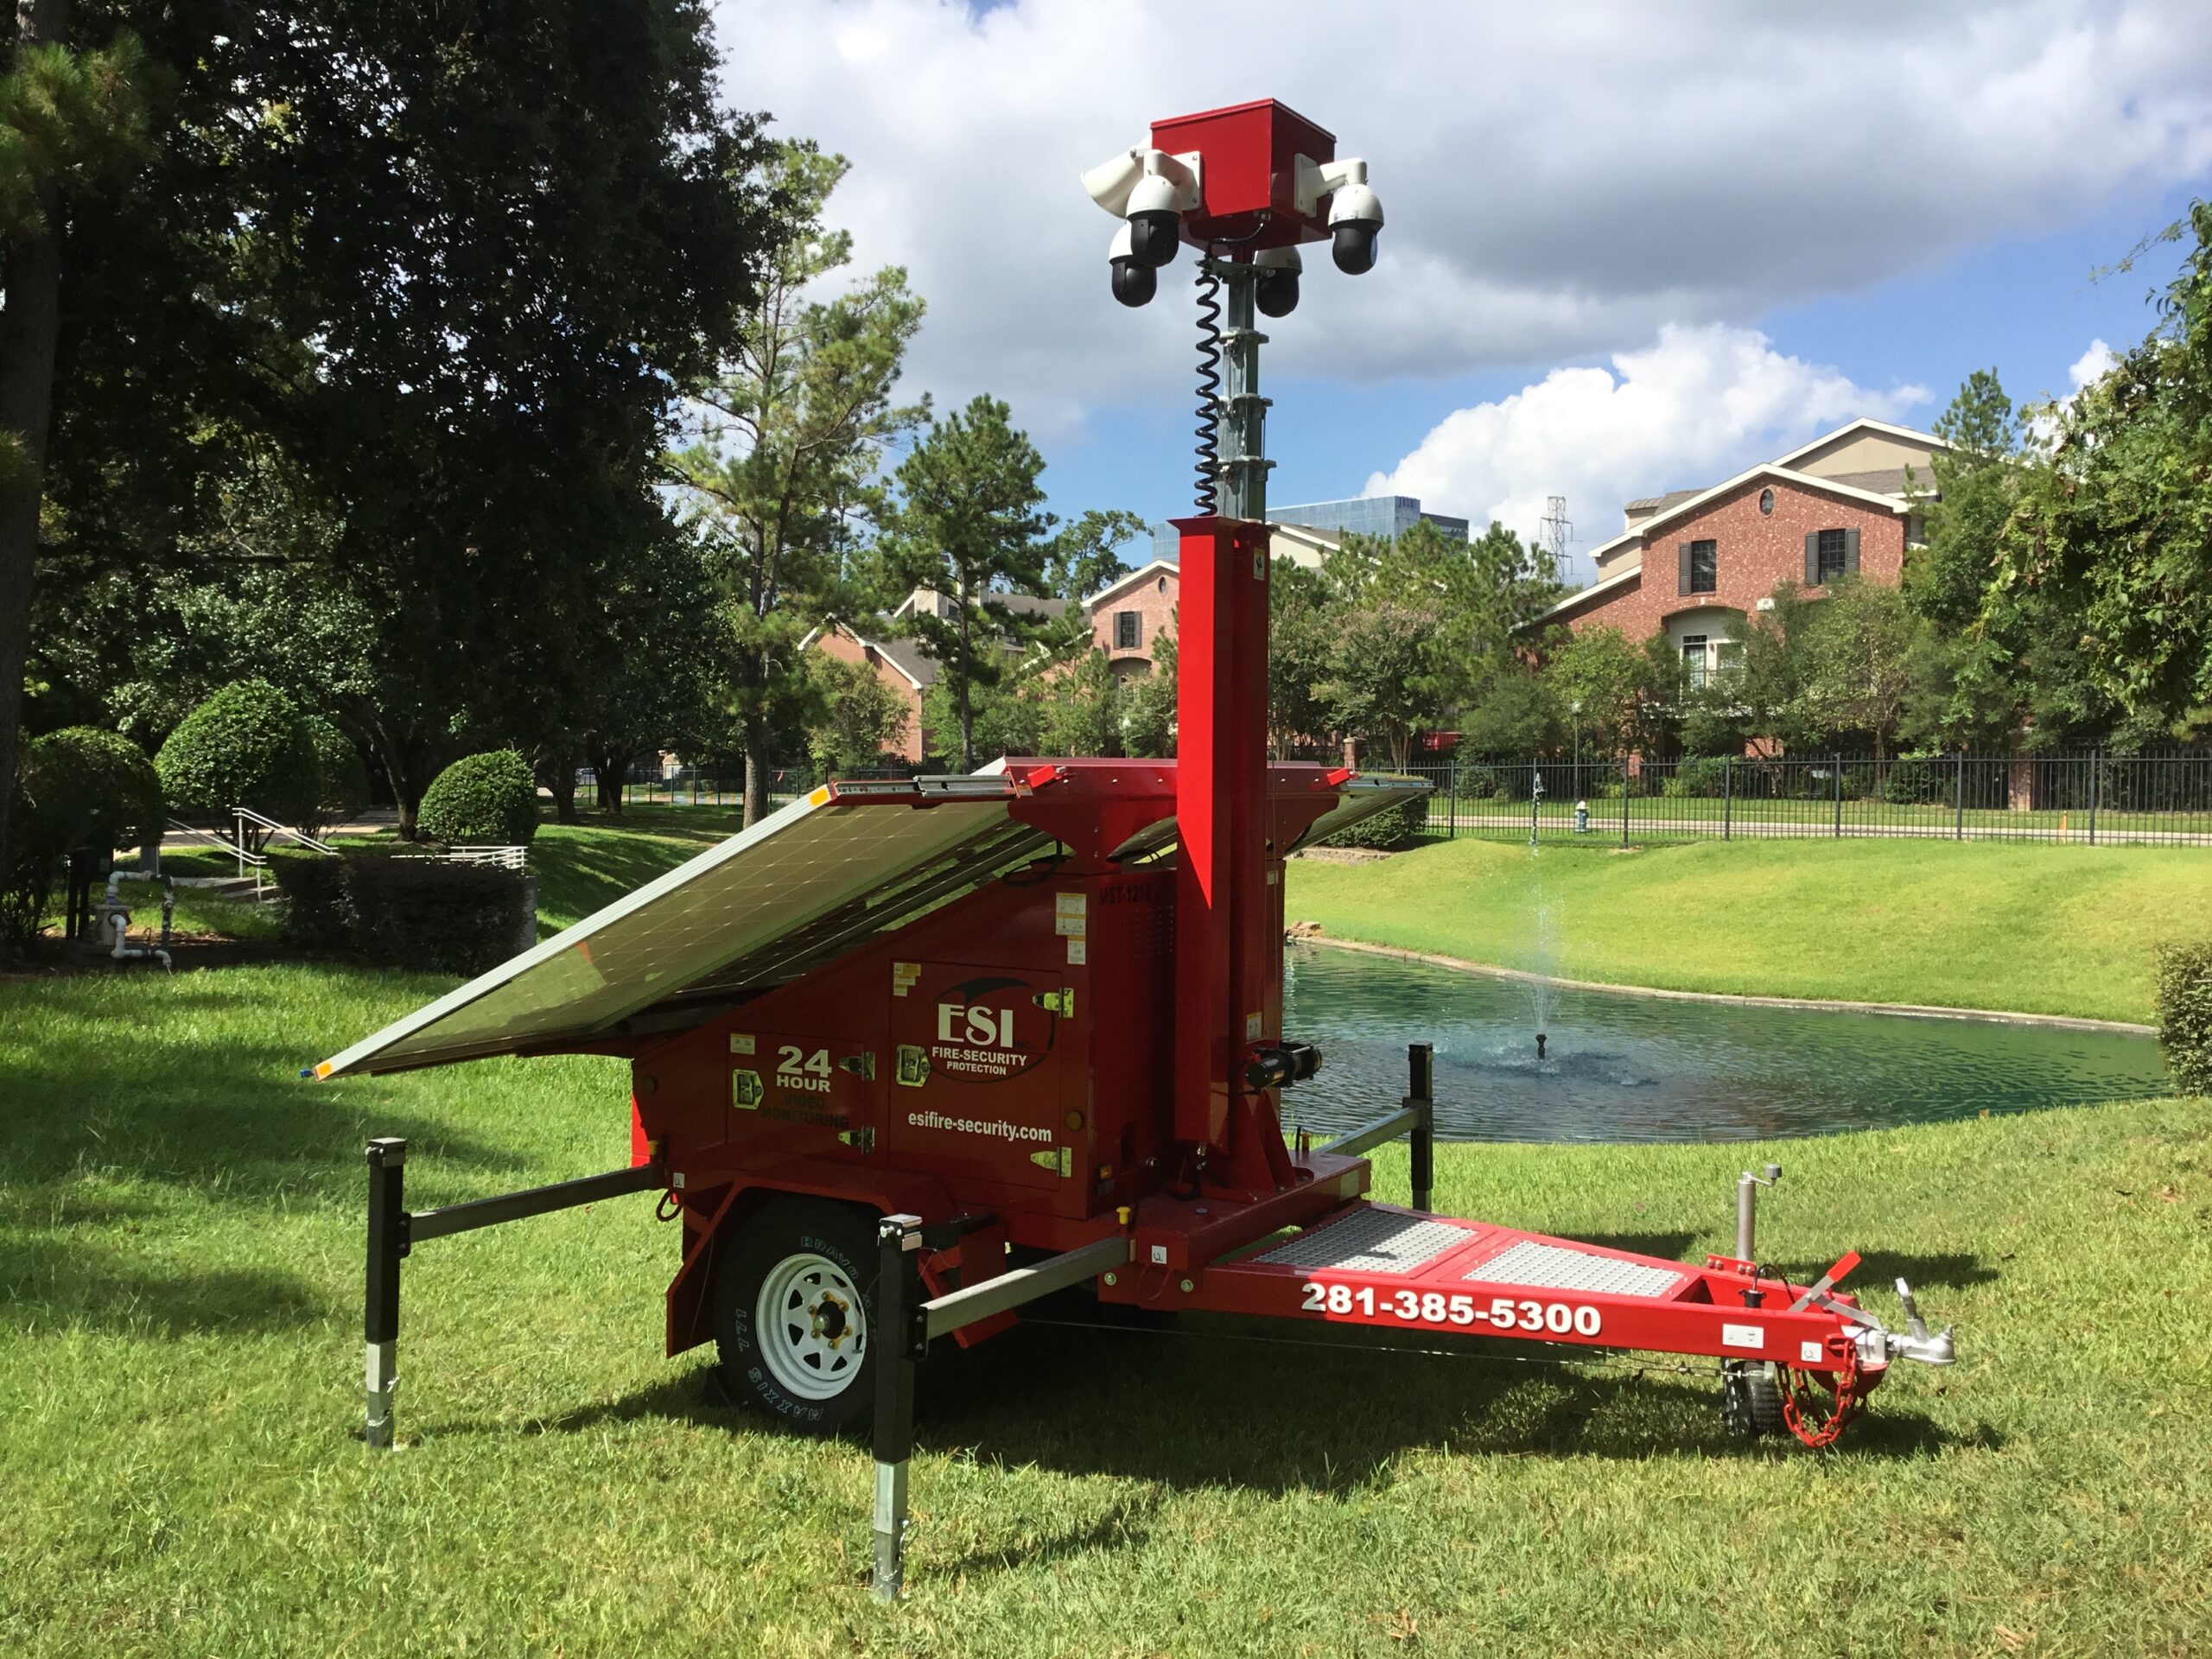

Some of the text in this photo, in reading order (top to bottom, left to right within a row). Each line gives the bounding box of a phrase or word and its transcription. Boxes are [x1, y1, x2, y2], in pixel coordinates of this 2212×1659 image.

[938, 1002, 1014, 1048] ESI
[777, 1046, 833, 1078] 24
[931, 1046, 1027, 1066] FIRE-SECURITY
[946, 1060, 1007, 1076] PROTECTION
[776, 1074, 831, 1093] HOUR
[784, 1093, 826, 1109] VIDEO
[907, 1110, 1052, 1142] esifire-security.com
[1300, 1282, 1602, 1337] 281-385-5300
[747, 1367, 824, 1421] MAXXIS
